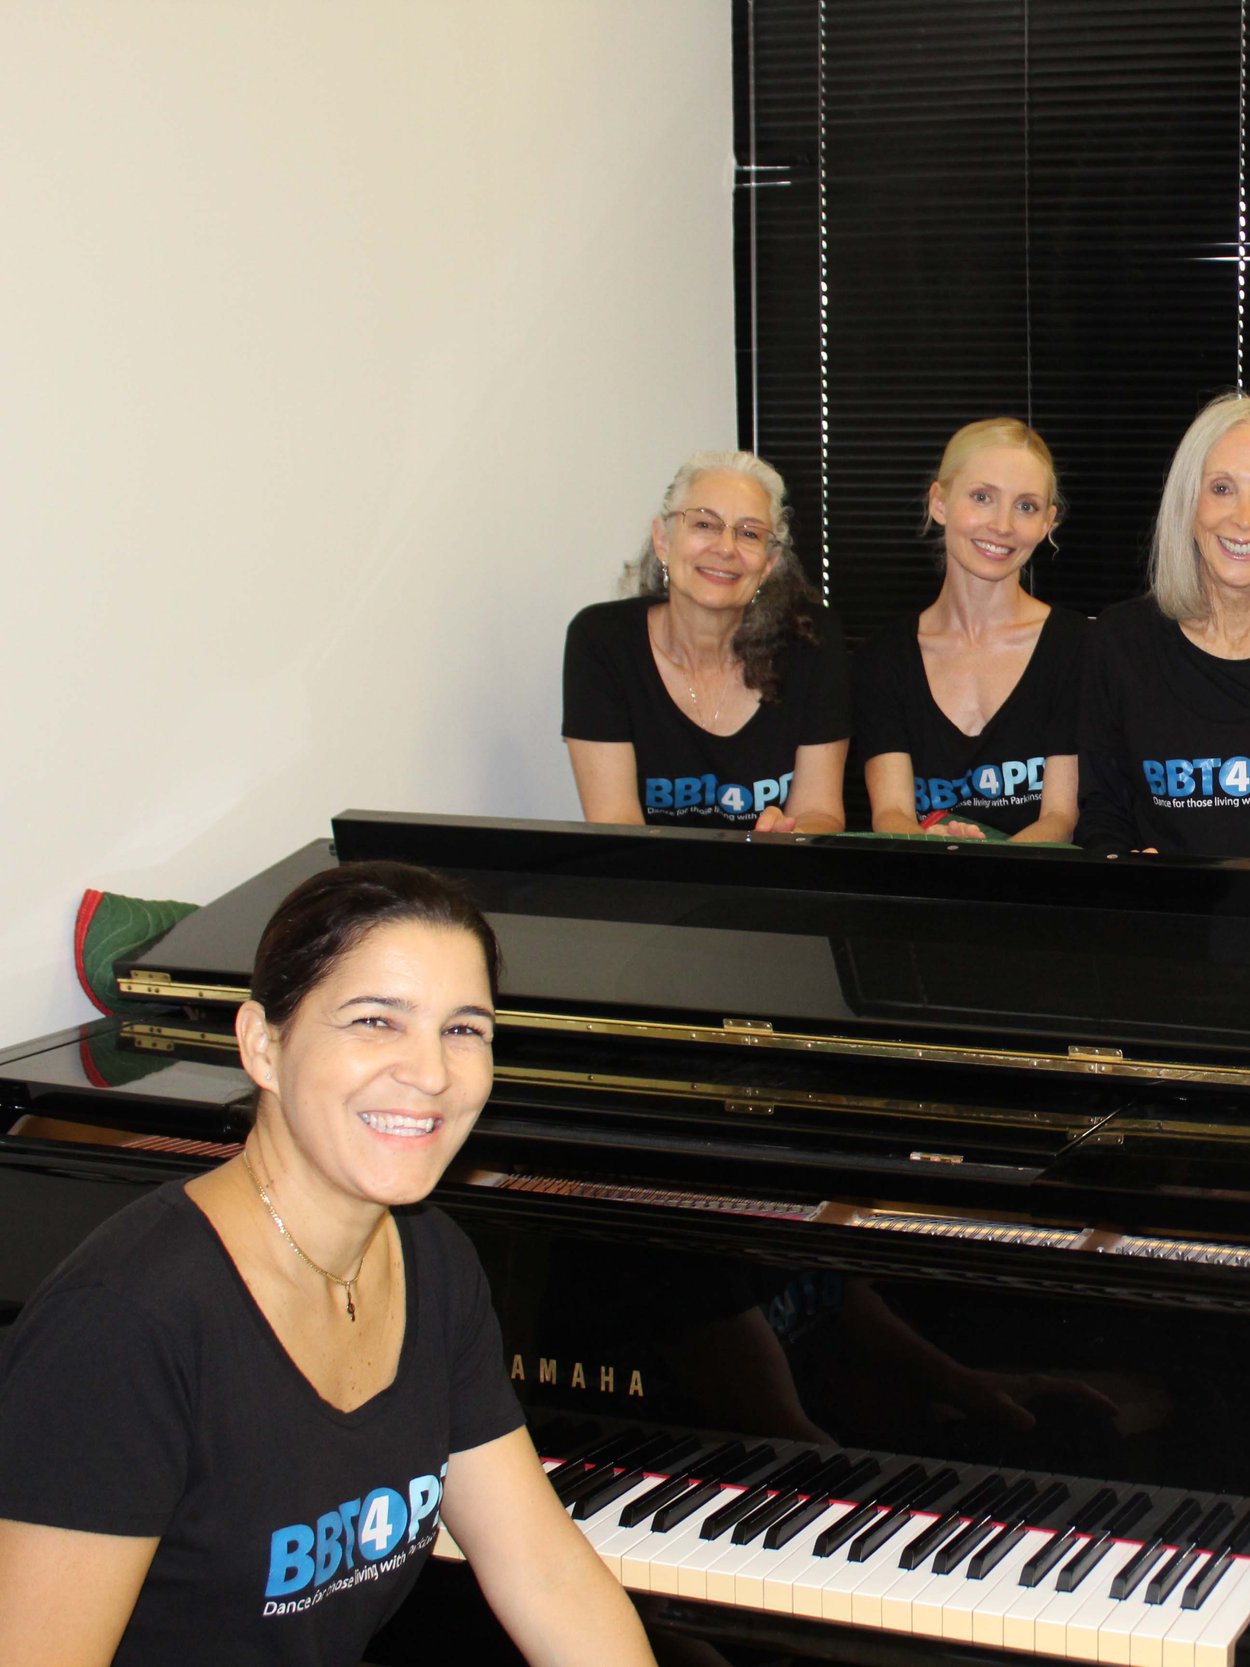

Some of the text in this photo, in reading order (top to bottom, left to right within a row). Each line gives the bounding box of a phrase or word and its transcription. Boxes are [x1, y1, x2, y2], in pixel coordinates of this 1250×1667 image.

[676, 807, 688, 816] for
[736, 812, 757, 820] with
[1172, 798, 1185, 808] for
[1186, 797, 1213, 808] those
[1214, 796, 1240, 808] living
[510, 1354, 644, 1397] AMAHA
[263, 1596, 311, 1617] Dance
[354, 1563, 379, 1586] living
[379, 1551, 407, 1573] with
